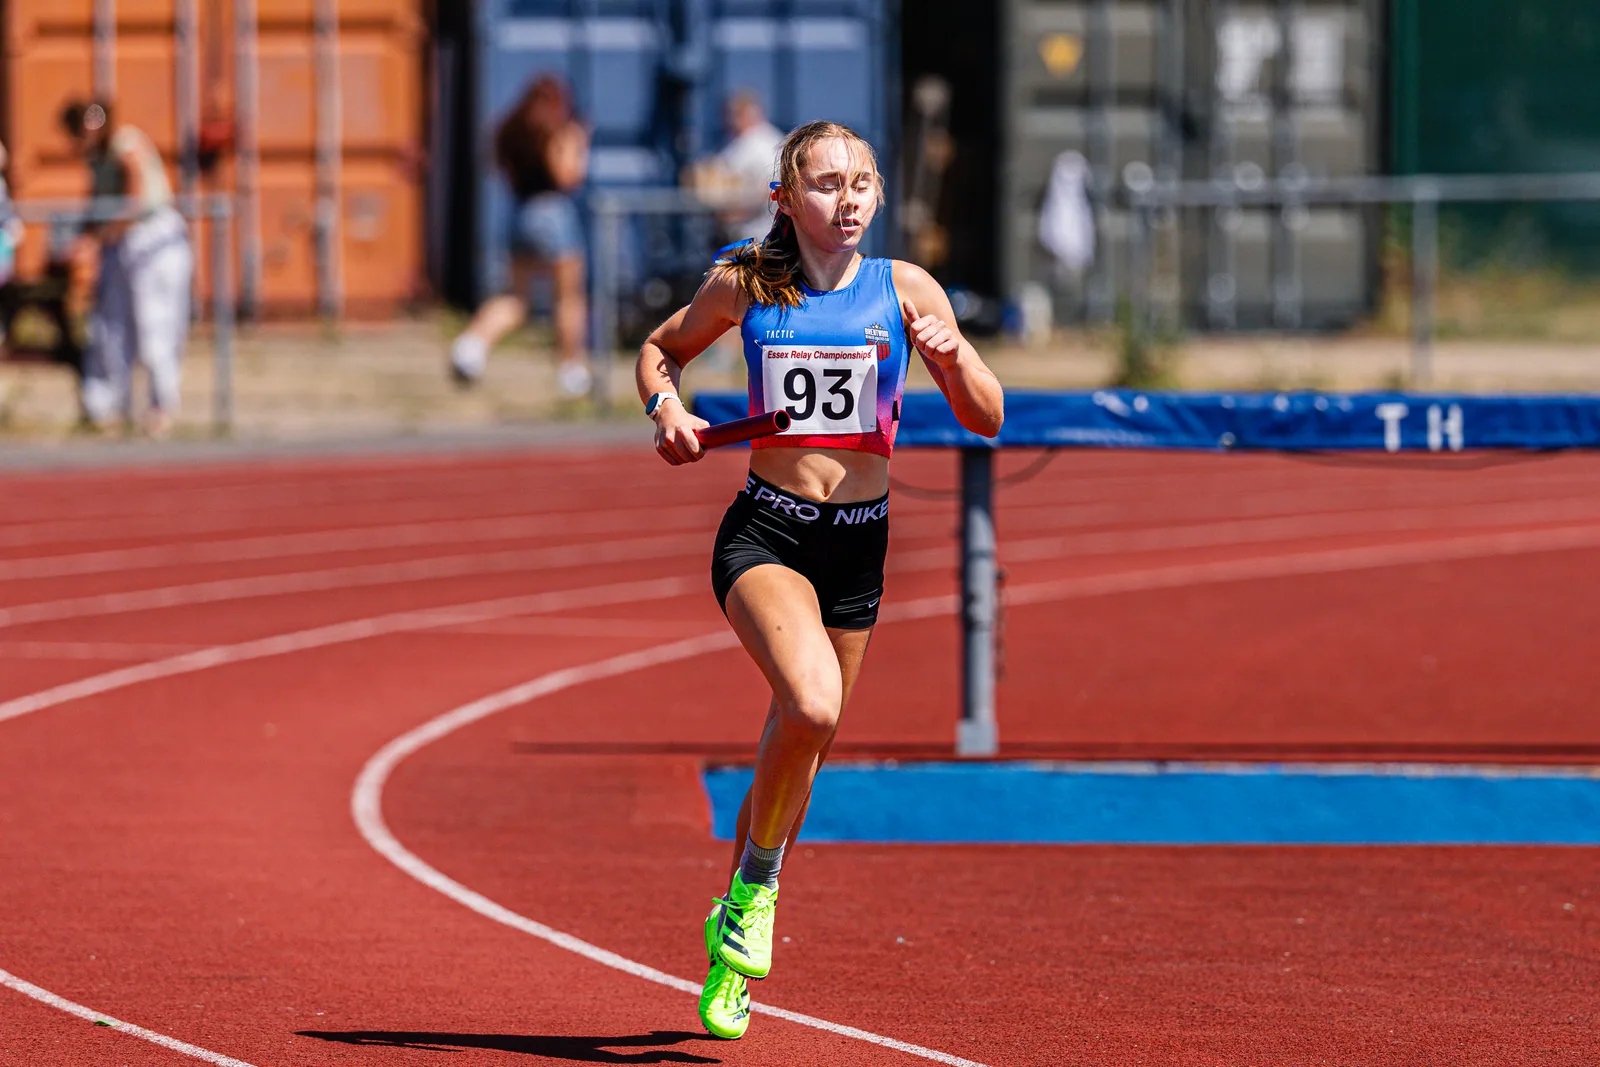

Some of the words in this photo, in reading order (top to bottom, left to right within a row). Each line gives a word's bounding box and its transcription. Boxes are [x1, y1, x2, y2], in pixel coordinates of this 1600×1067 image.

[766, 330, 795, 339] TACTIC
[767, 350, 789, 359] Essex
[790, 350, 812, 361] Relay
[813, 350, 872, 361] Championships
[783, 367, 855, 421] 93
[754, 486, 820, 521] PRO
[833, 498, 888, 525] NIKE
